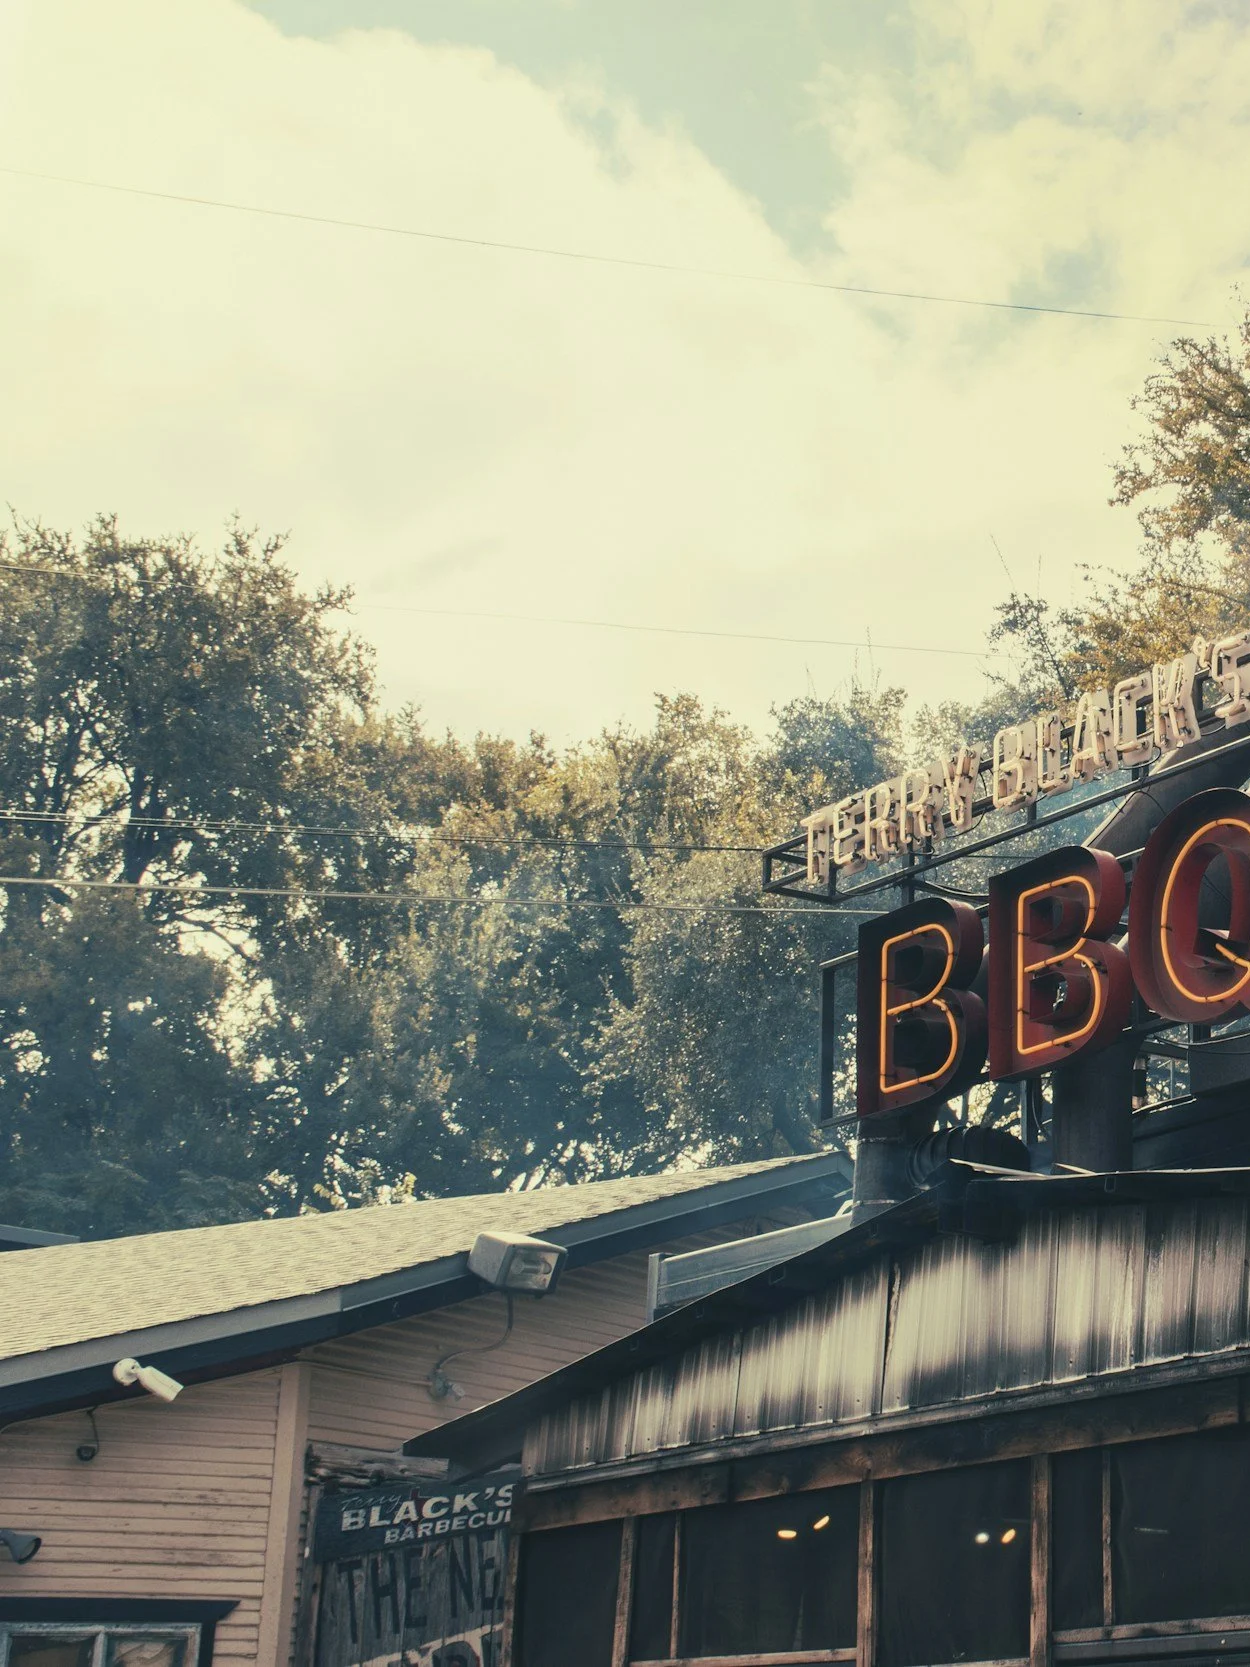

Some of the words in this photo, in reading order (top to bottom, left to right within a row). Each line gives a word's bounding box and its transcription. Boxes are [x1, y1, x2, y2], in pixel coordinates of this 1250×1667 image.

[800, 743, 984, 886] TERRY
[341, 1484, 516, 1532] BLACK'S
[338, 1547, 428, 1645] THE
